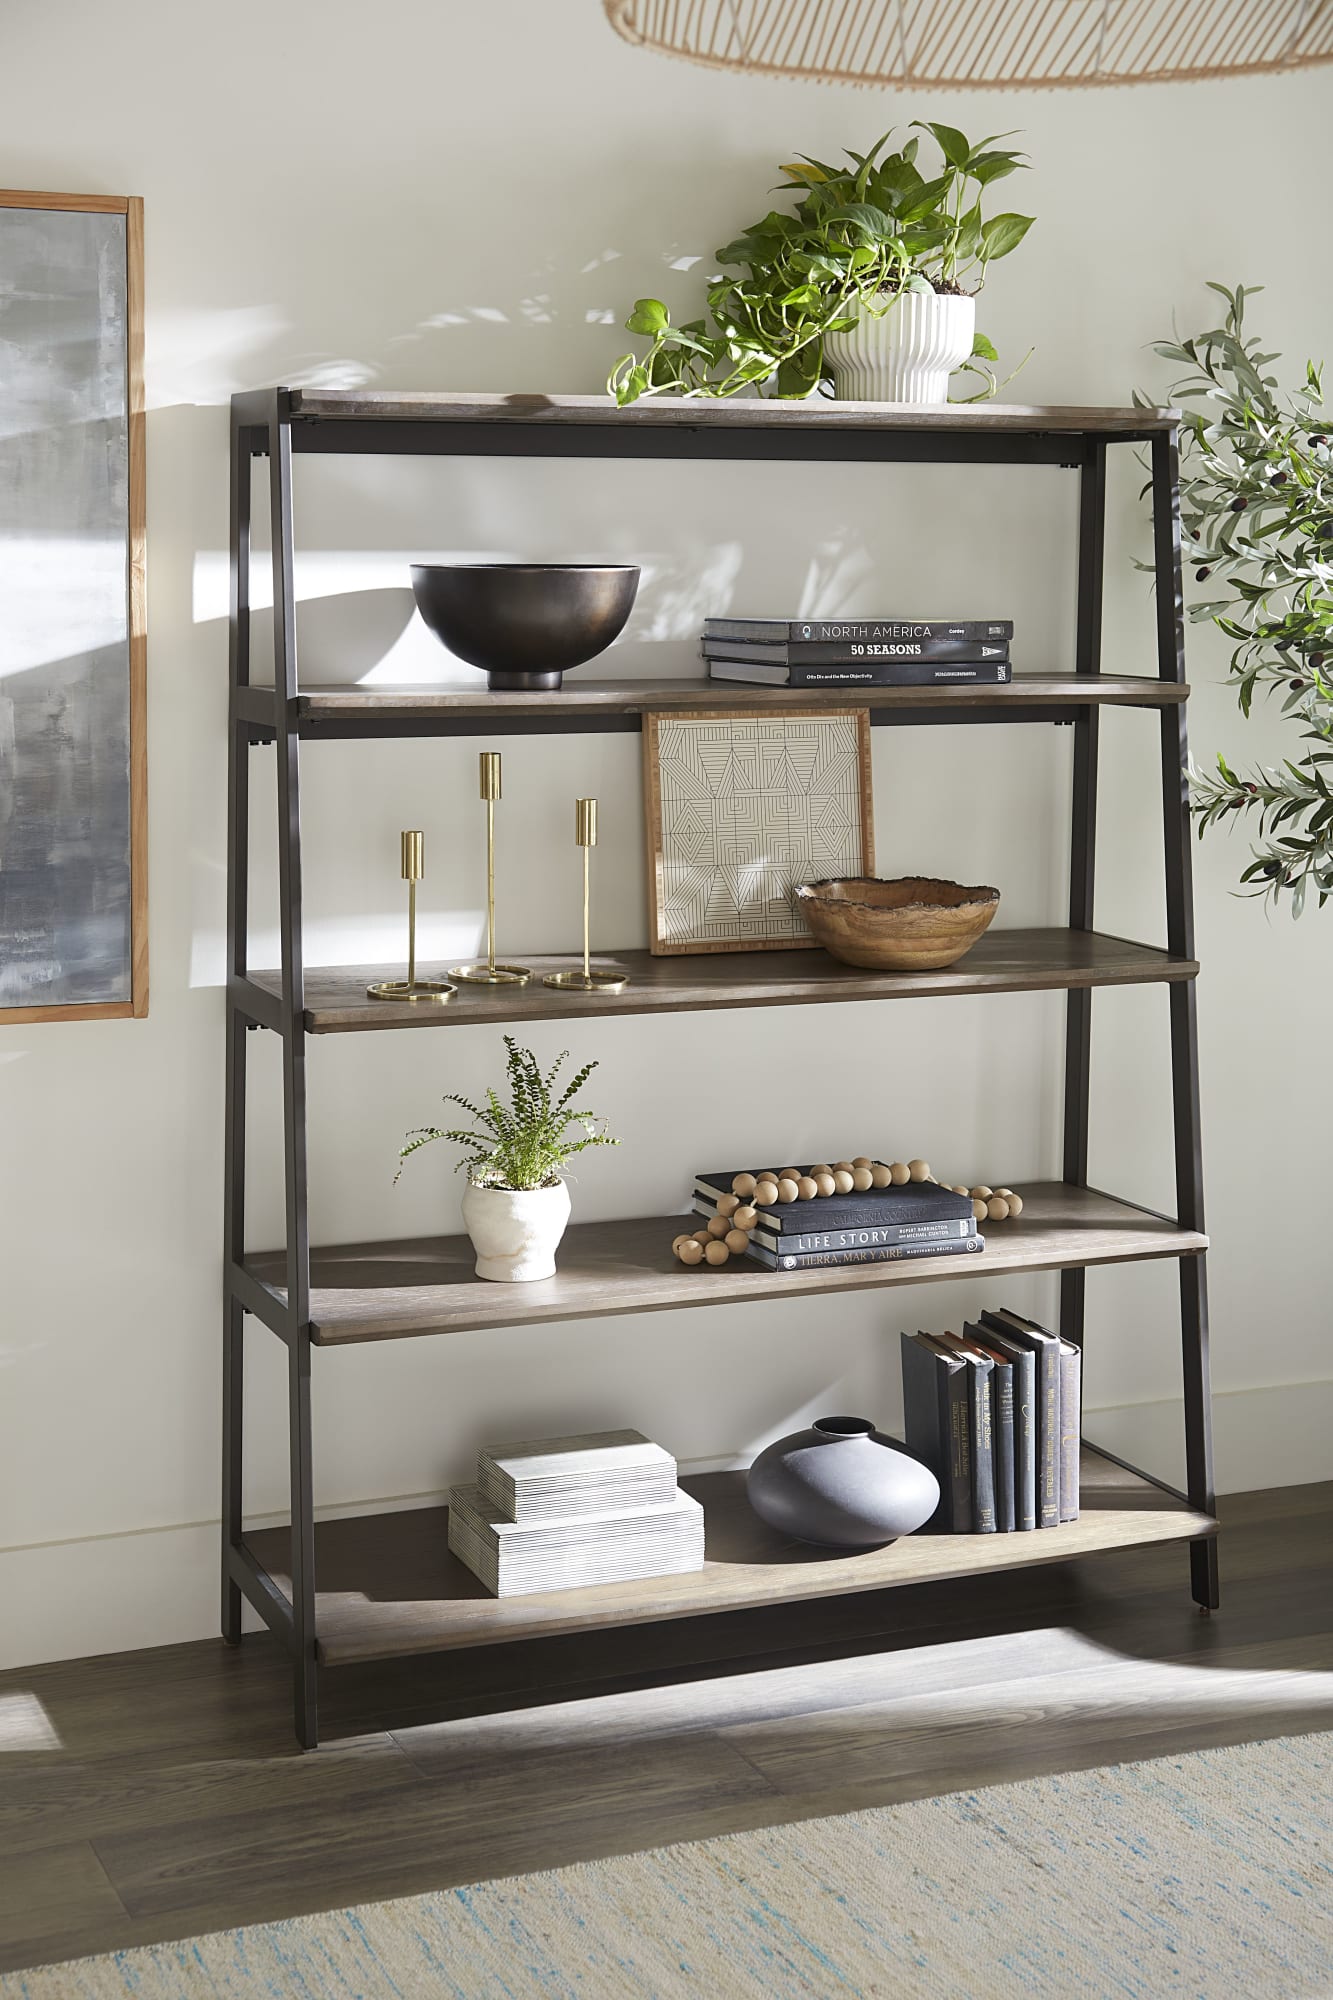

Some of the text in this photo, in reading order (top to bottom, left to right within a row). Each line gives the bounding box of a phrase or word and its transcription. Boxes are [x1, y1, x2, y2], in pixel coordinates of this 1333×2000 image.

[822, 626, 932, 637] NORTH AMERICA
[851, 644, 921, 655] 50 SEASONS
[799, 1231, 889, 1249] LIFE STORY
[801, 1248, 902, 1266] TIERRA, MAR Y AIRE
[983, 1412, 991, 1425] My
[984, 1426, 992, 1449] Shoes
